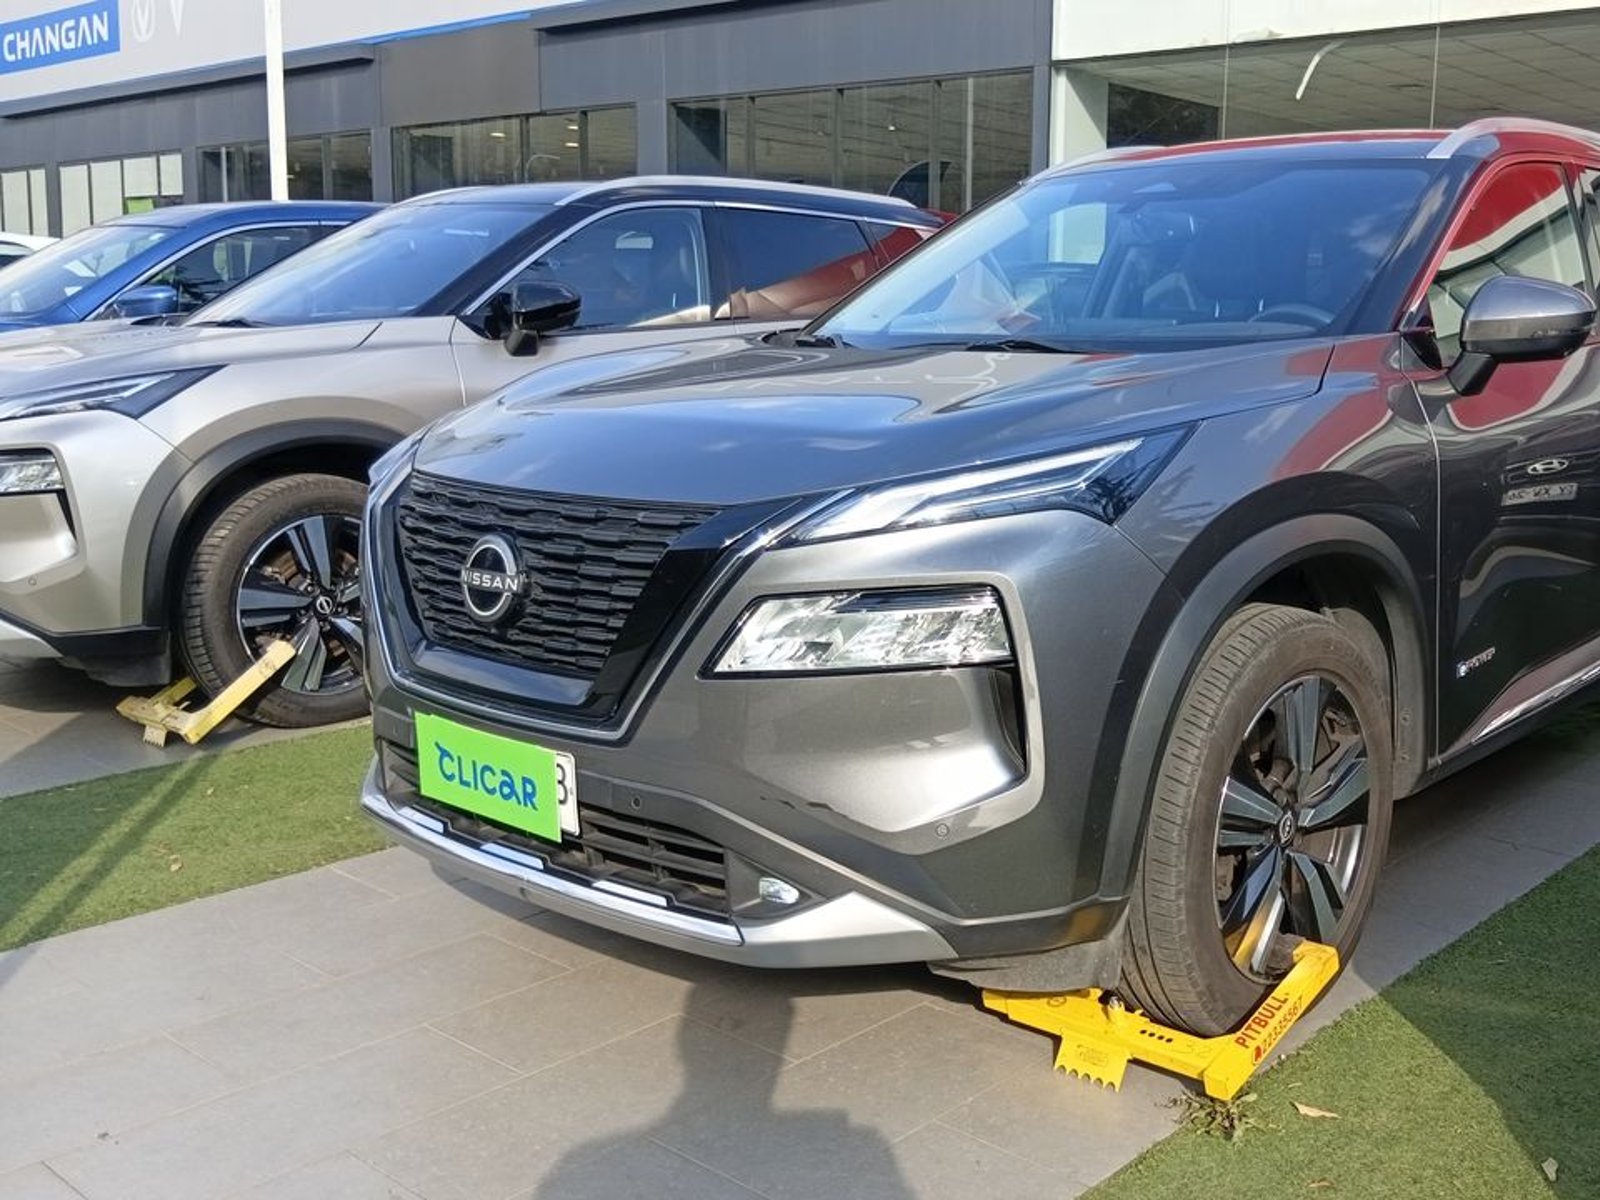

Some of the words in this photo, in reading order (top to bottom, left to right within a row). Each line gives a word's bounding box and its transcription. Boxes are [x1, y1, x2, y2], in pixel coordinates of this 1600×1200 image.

[3, 11, 108, 62] CHANGAN
[461, 566, 518, 591] NISSAN
[1235, 996, 1289, 1048] PITBULL
